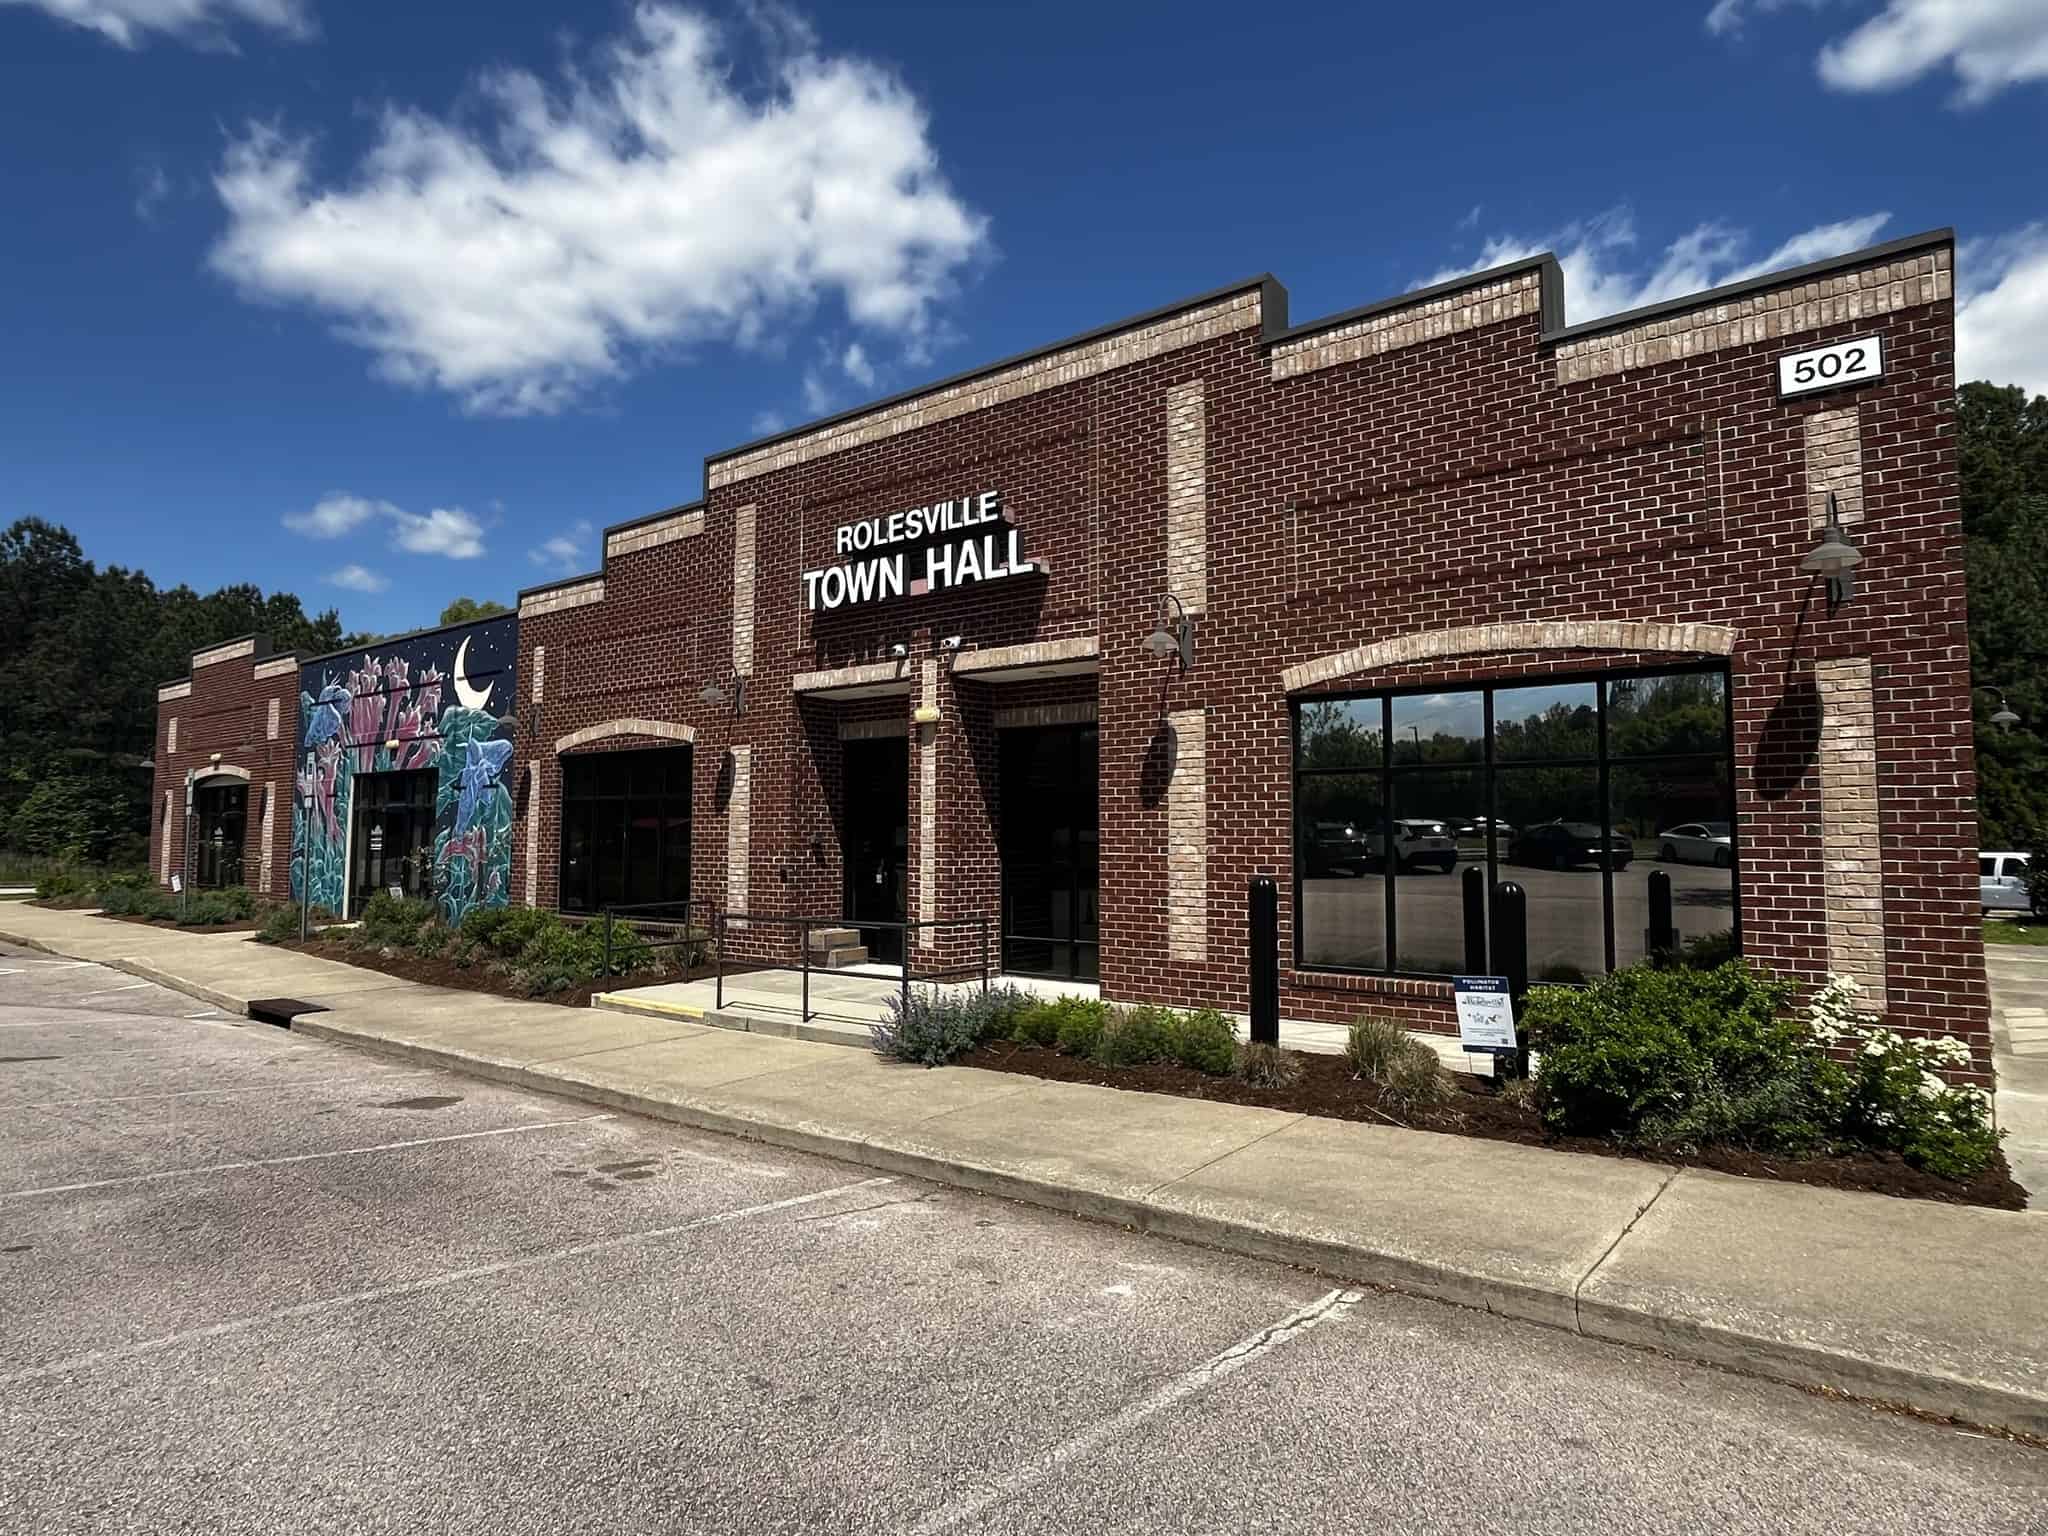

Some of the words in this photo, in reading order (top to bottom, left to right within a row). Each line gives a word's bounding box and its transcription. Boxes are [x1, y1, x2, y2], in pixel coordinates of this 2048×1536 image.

[1794, 348, 1867, 384] 502
[836, 490, 999, 554] ROLESVILLE
[803, 553, 904, 610] TOWN
[926, 529, 1034, 590] HALL
